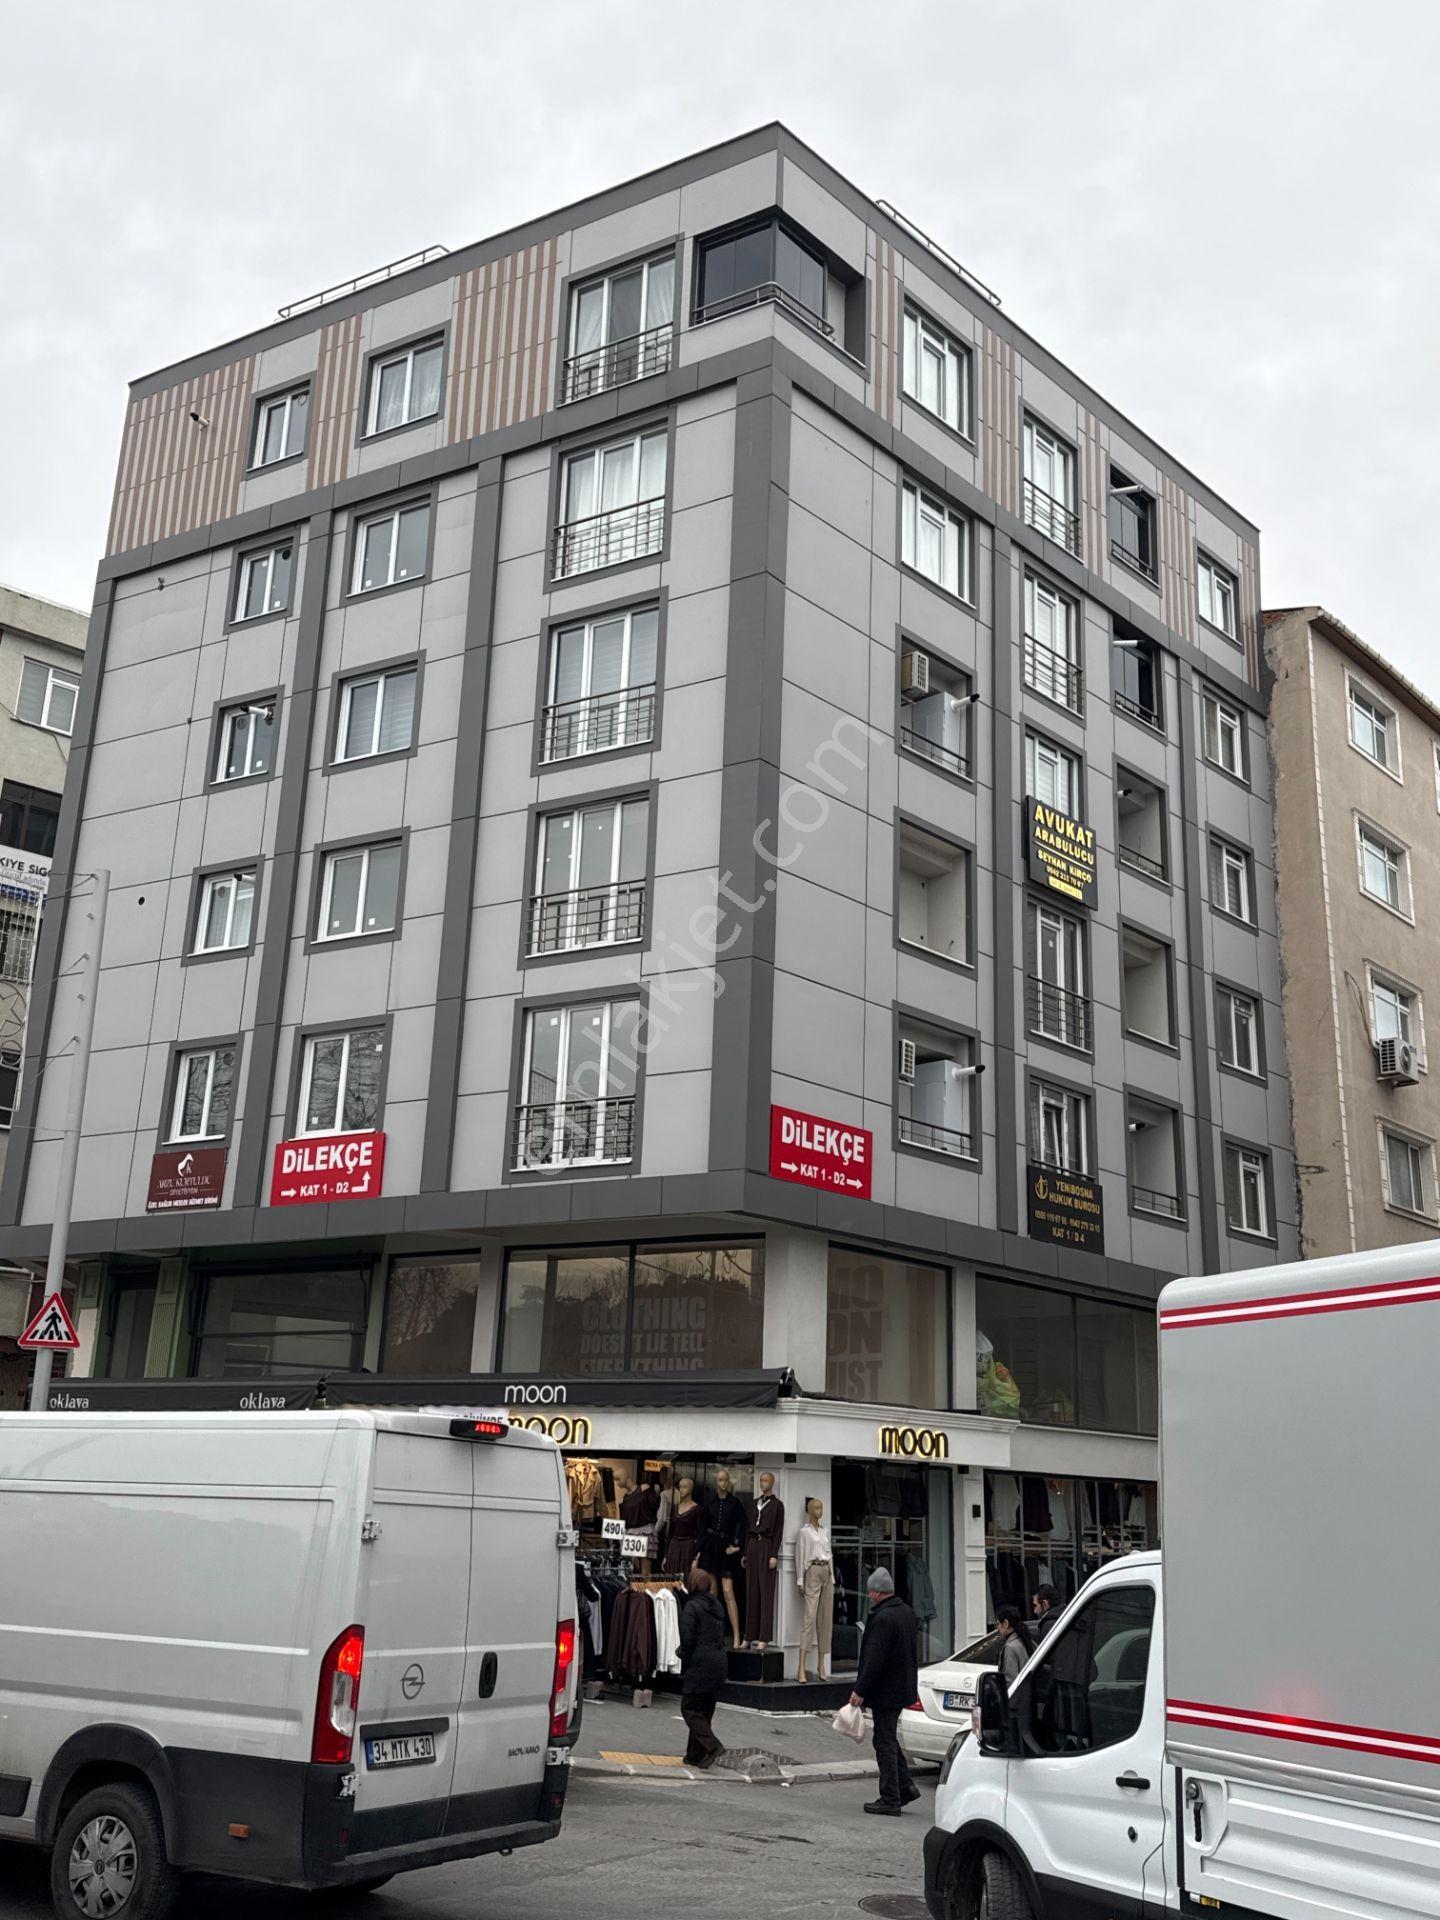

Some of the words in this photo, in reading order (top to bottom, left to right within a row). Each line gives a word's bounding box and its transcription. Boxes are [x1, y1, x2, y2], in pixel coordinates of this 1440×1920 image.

[1034, 804, 1093, 849] AVUKAT
[1034, 826, 1094, 866] ARABULUCU
[800, 1162, 819, 1179] KAT
[820, 1169, 826, 1181] 1
[833, 1171, 845, 1186] D2
[299, 1184, 320, 1197] KAT
[322, 1183, 328, 1195] 1
[335, 1181, 349, 1194] D2
[1048, 1191, 1073, 1207] HUKUK
[1052, 1226, 1065, 1239] KAT
[581, 1296, 706, 1331] CLOTHING
[646, 1332, 669, 1353] LIE
[670, 1332, 705, 1353] TELL
[49, 1393, 89, 1409] oklava
[239, 1392, 286, 1410] oklava
[504, 1384, 567, 1404] moon
[880, 1425, 949, 1459] moon
[959, 1696, 970, 1707] RK
[374, 1741, 388, 1761] 34
[391, 1739, 411, 1759] MTK
[413, 1737, 432, 1757] 430
